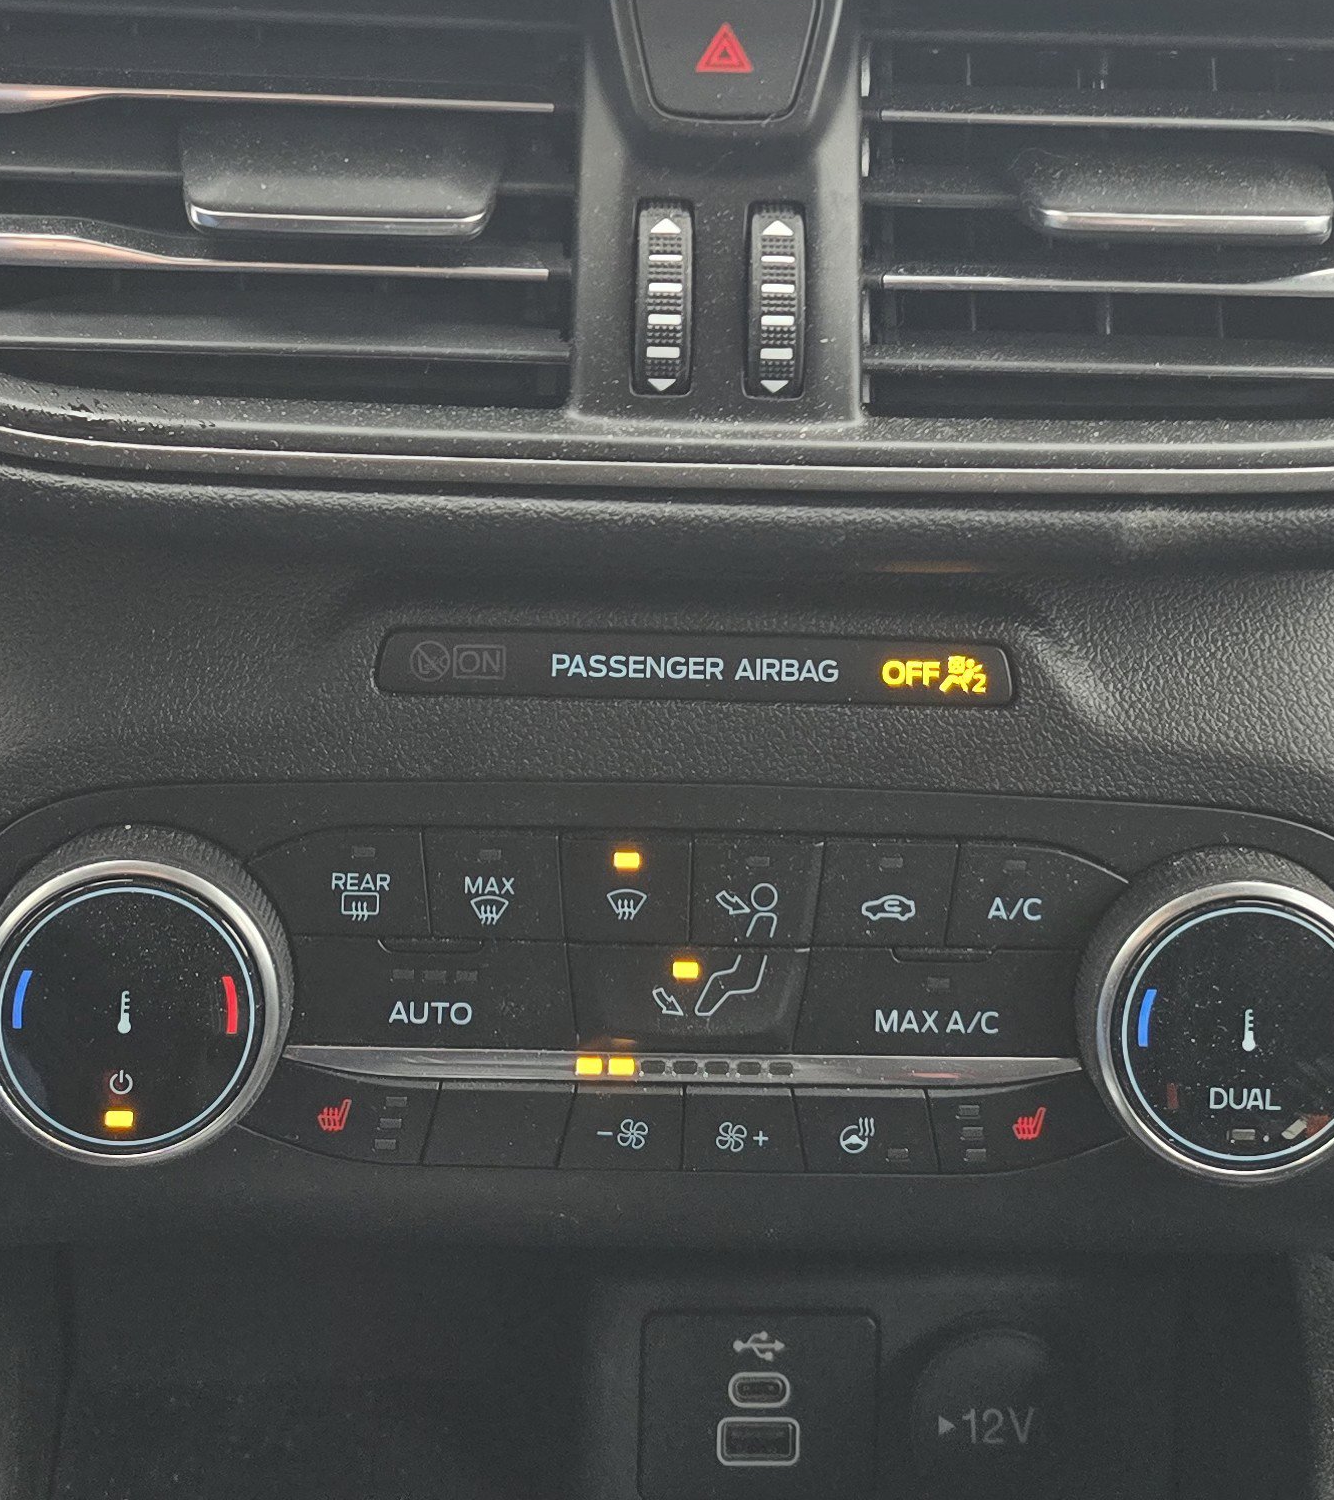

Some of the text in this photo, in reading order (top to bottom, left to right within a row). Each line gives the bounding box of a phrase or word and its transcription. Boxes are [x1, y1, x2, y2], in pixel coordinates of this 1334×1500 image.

[551, 654, 840, 683] PASSENGER AIRBAG
[881, 660, 941, 686] OFF
[331, 873, 391, 891] REAR
[464, 877, 515, 895] MAX
[988, 897, 1042, 921] A/C
[389, 1002, 473, 1025] AUTO
[875, 1011, 999, 1035] MAX A/C
[1209, 1088, 1281, 1111] DUAL
[961, 1406, 1036, 1444] 12V
